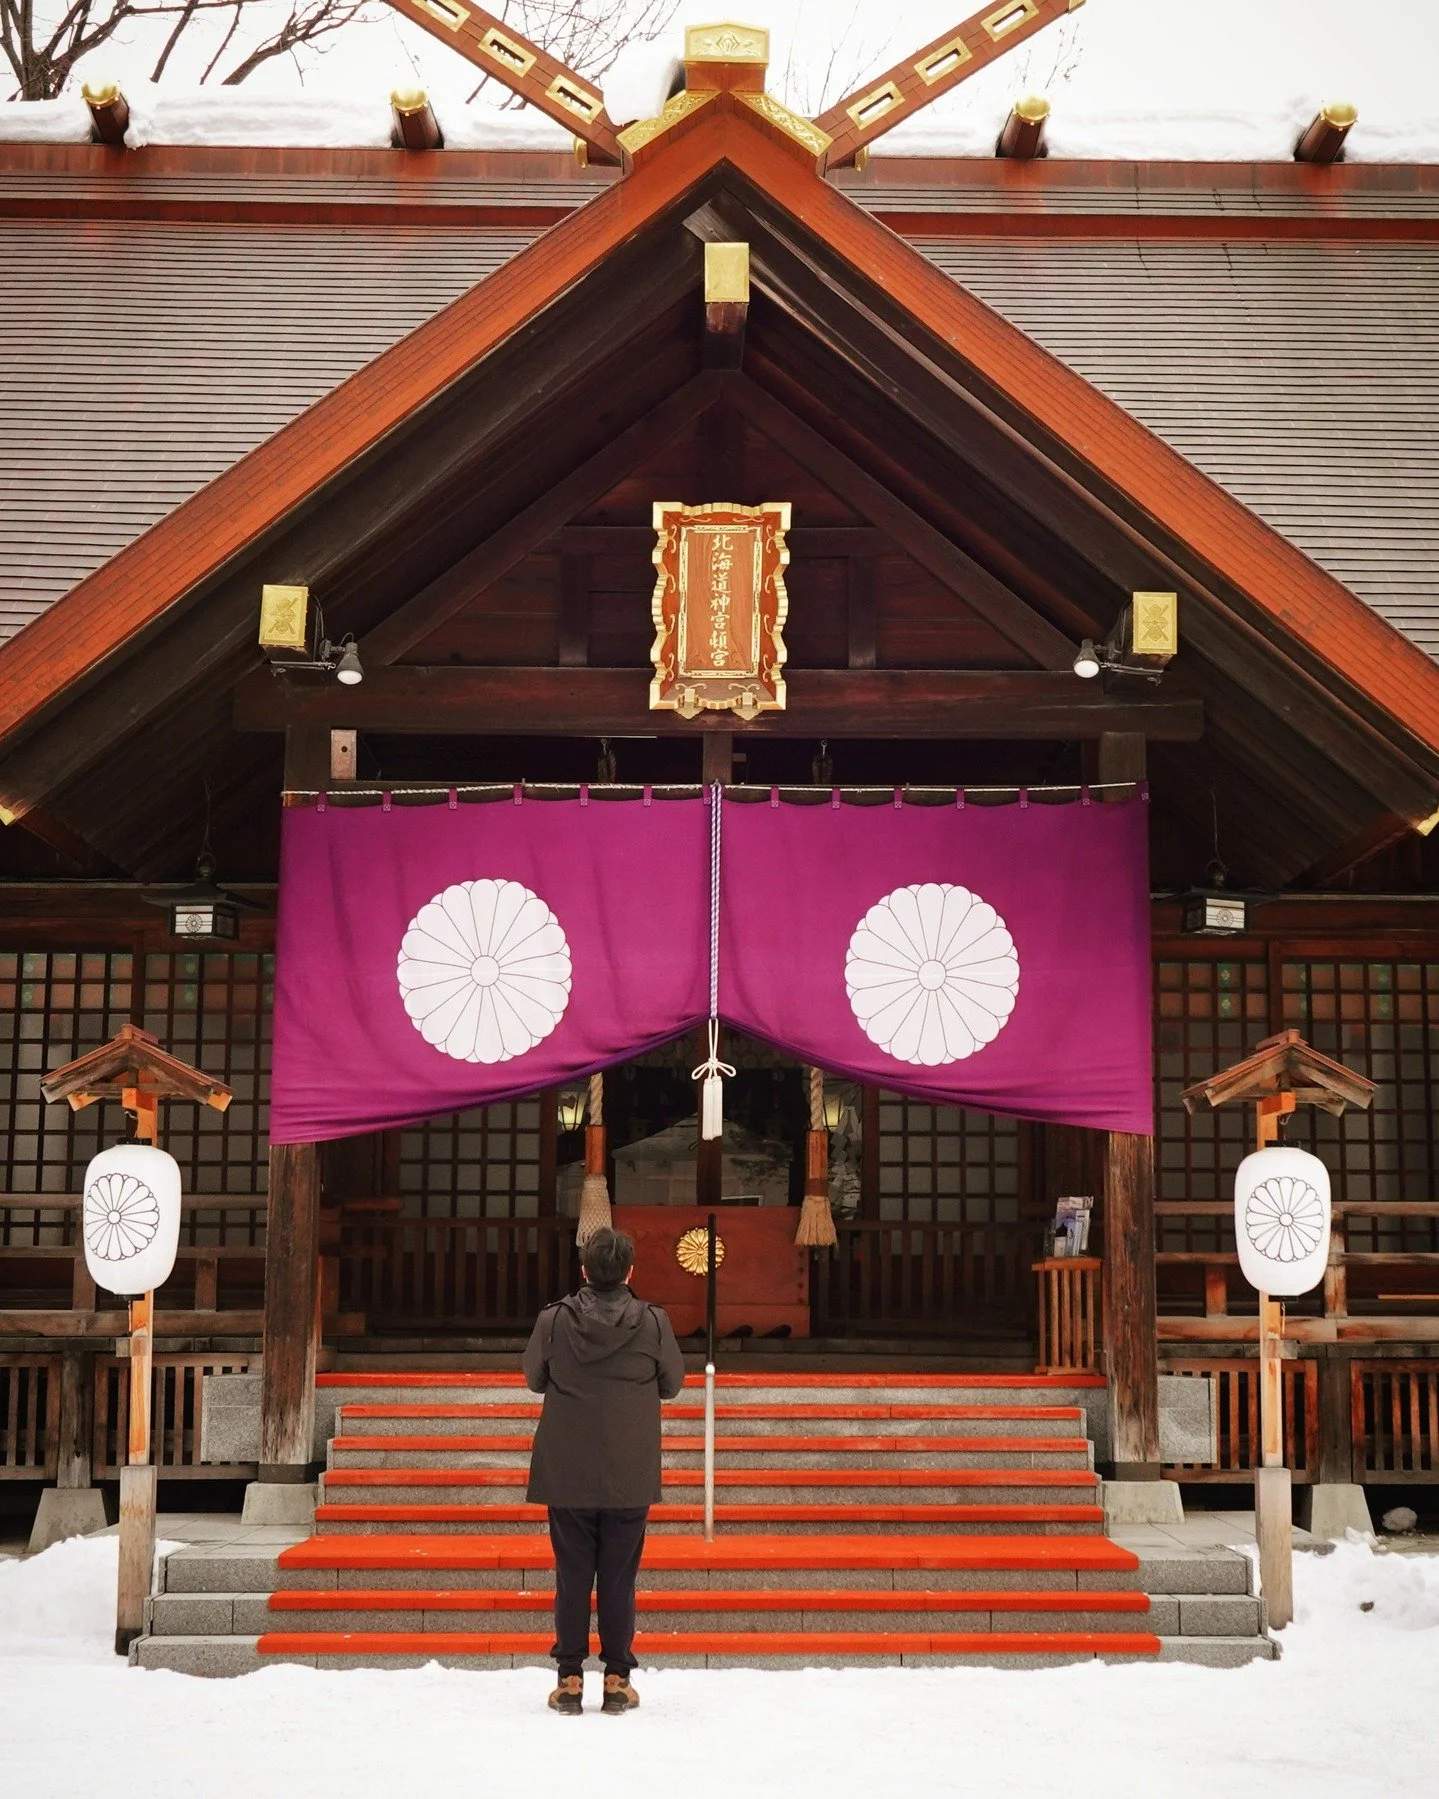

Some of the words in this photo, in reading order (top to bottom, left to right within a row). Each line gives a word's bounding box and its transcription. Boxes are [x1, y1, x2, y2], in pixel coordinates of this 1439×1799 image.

[709, 534, 733, 667] 北海道神宮頓宮
